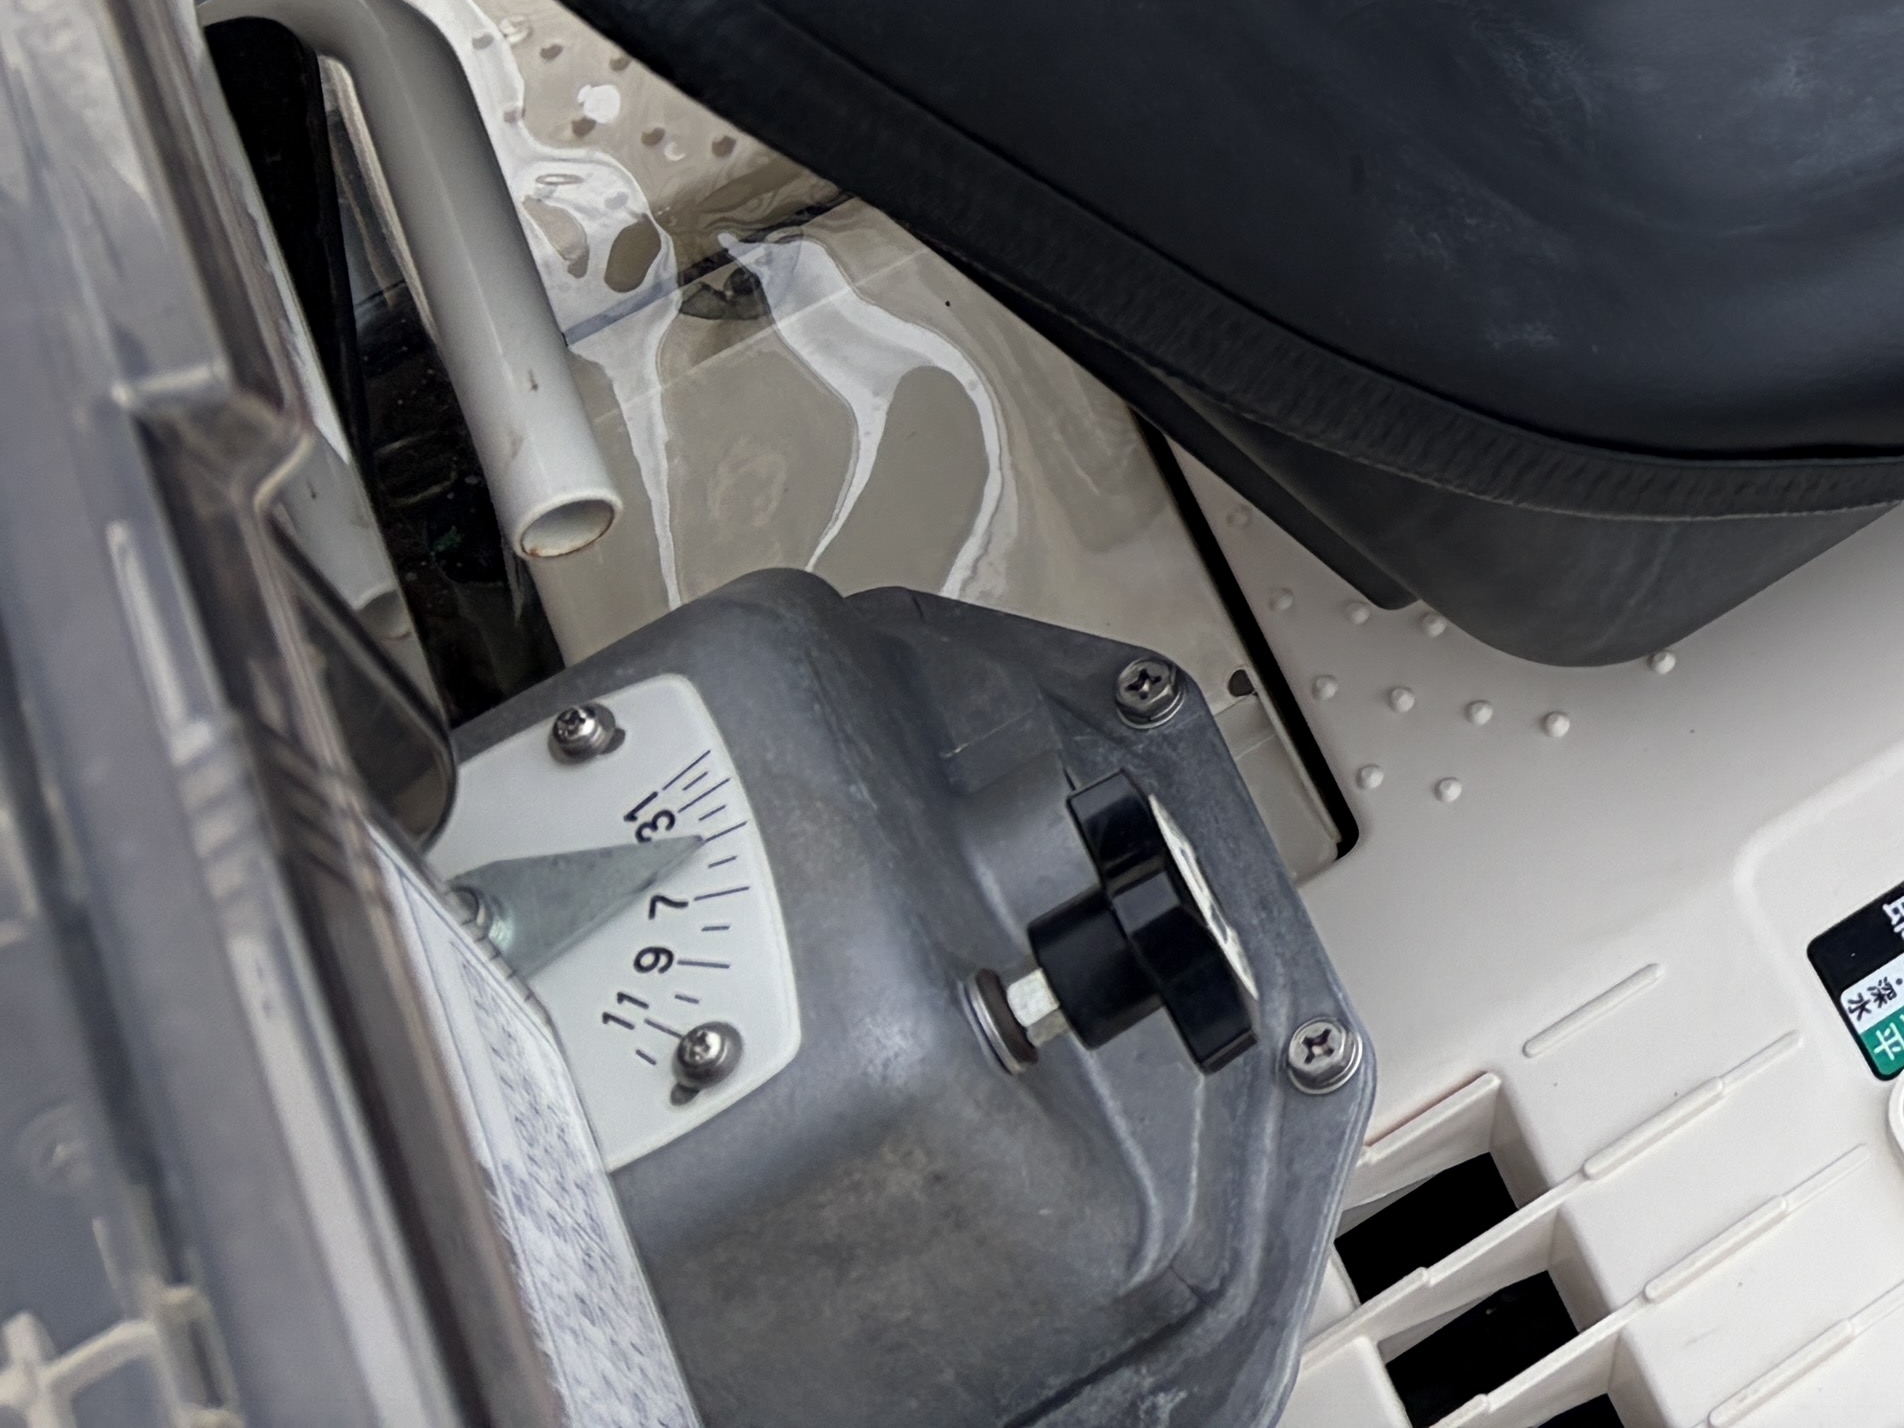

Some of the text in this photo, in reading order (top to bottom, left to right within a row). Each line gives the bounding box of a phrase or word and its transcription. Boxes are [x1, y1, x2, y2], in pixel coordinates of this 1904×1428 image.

[602, 791, 688, 1030] 1 3 7 9 11
